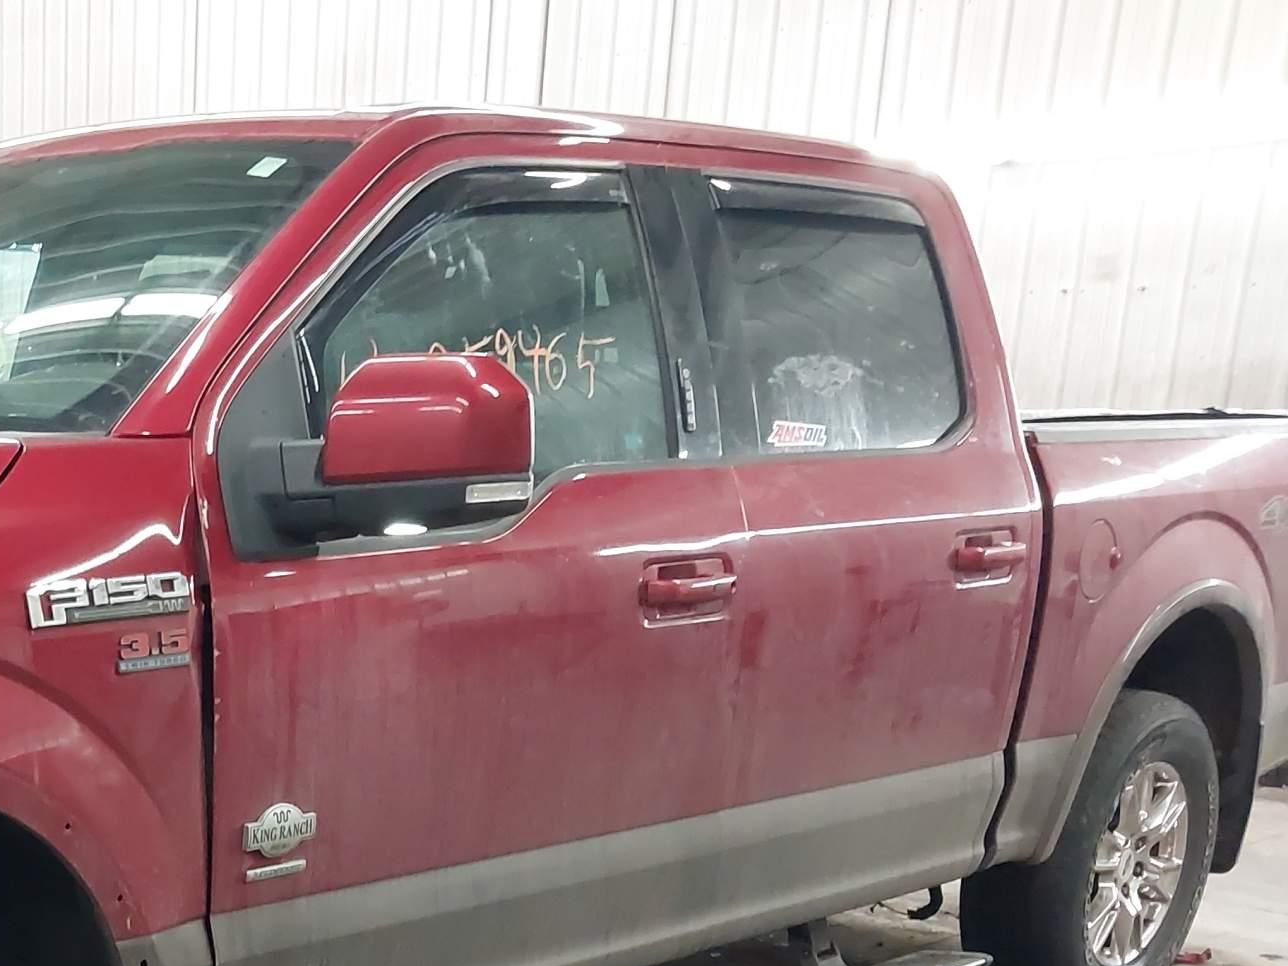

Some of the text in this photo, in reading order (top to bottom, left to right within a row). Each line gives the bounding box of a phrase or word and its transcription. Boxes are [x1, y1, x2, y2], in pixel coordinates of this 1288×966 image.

[772, 423, 825, 443] AMSOIL
[119, 628, 189, 660] 3.5
[252, 818, 312, 845] KING RANCH
